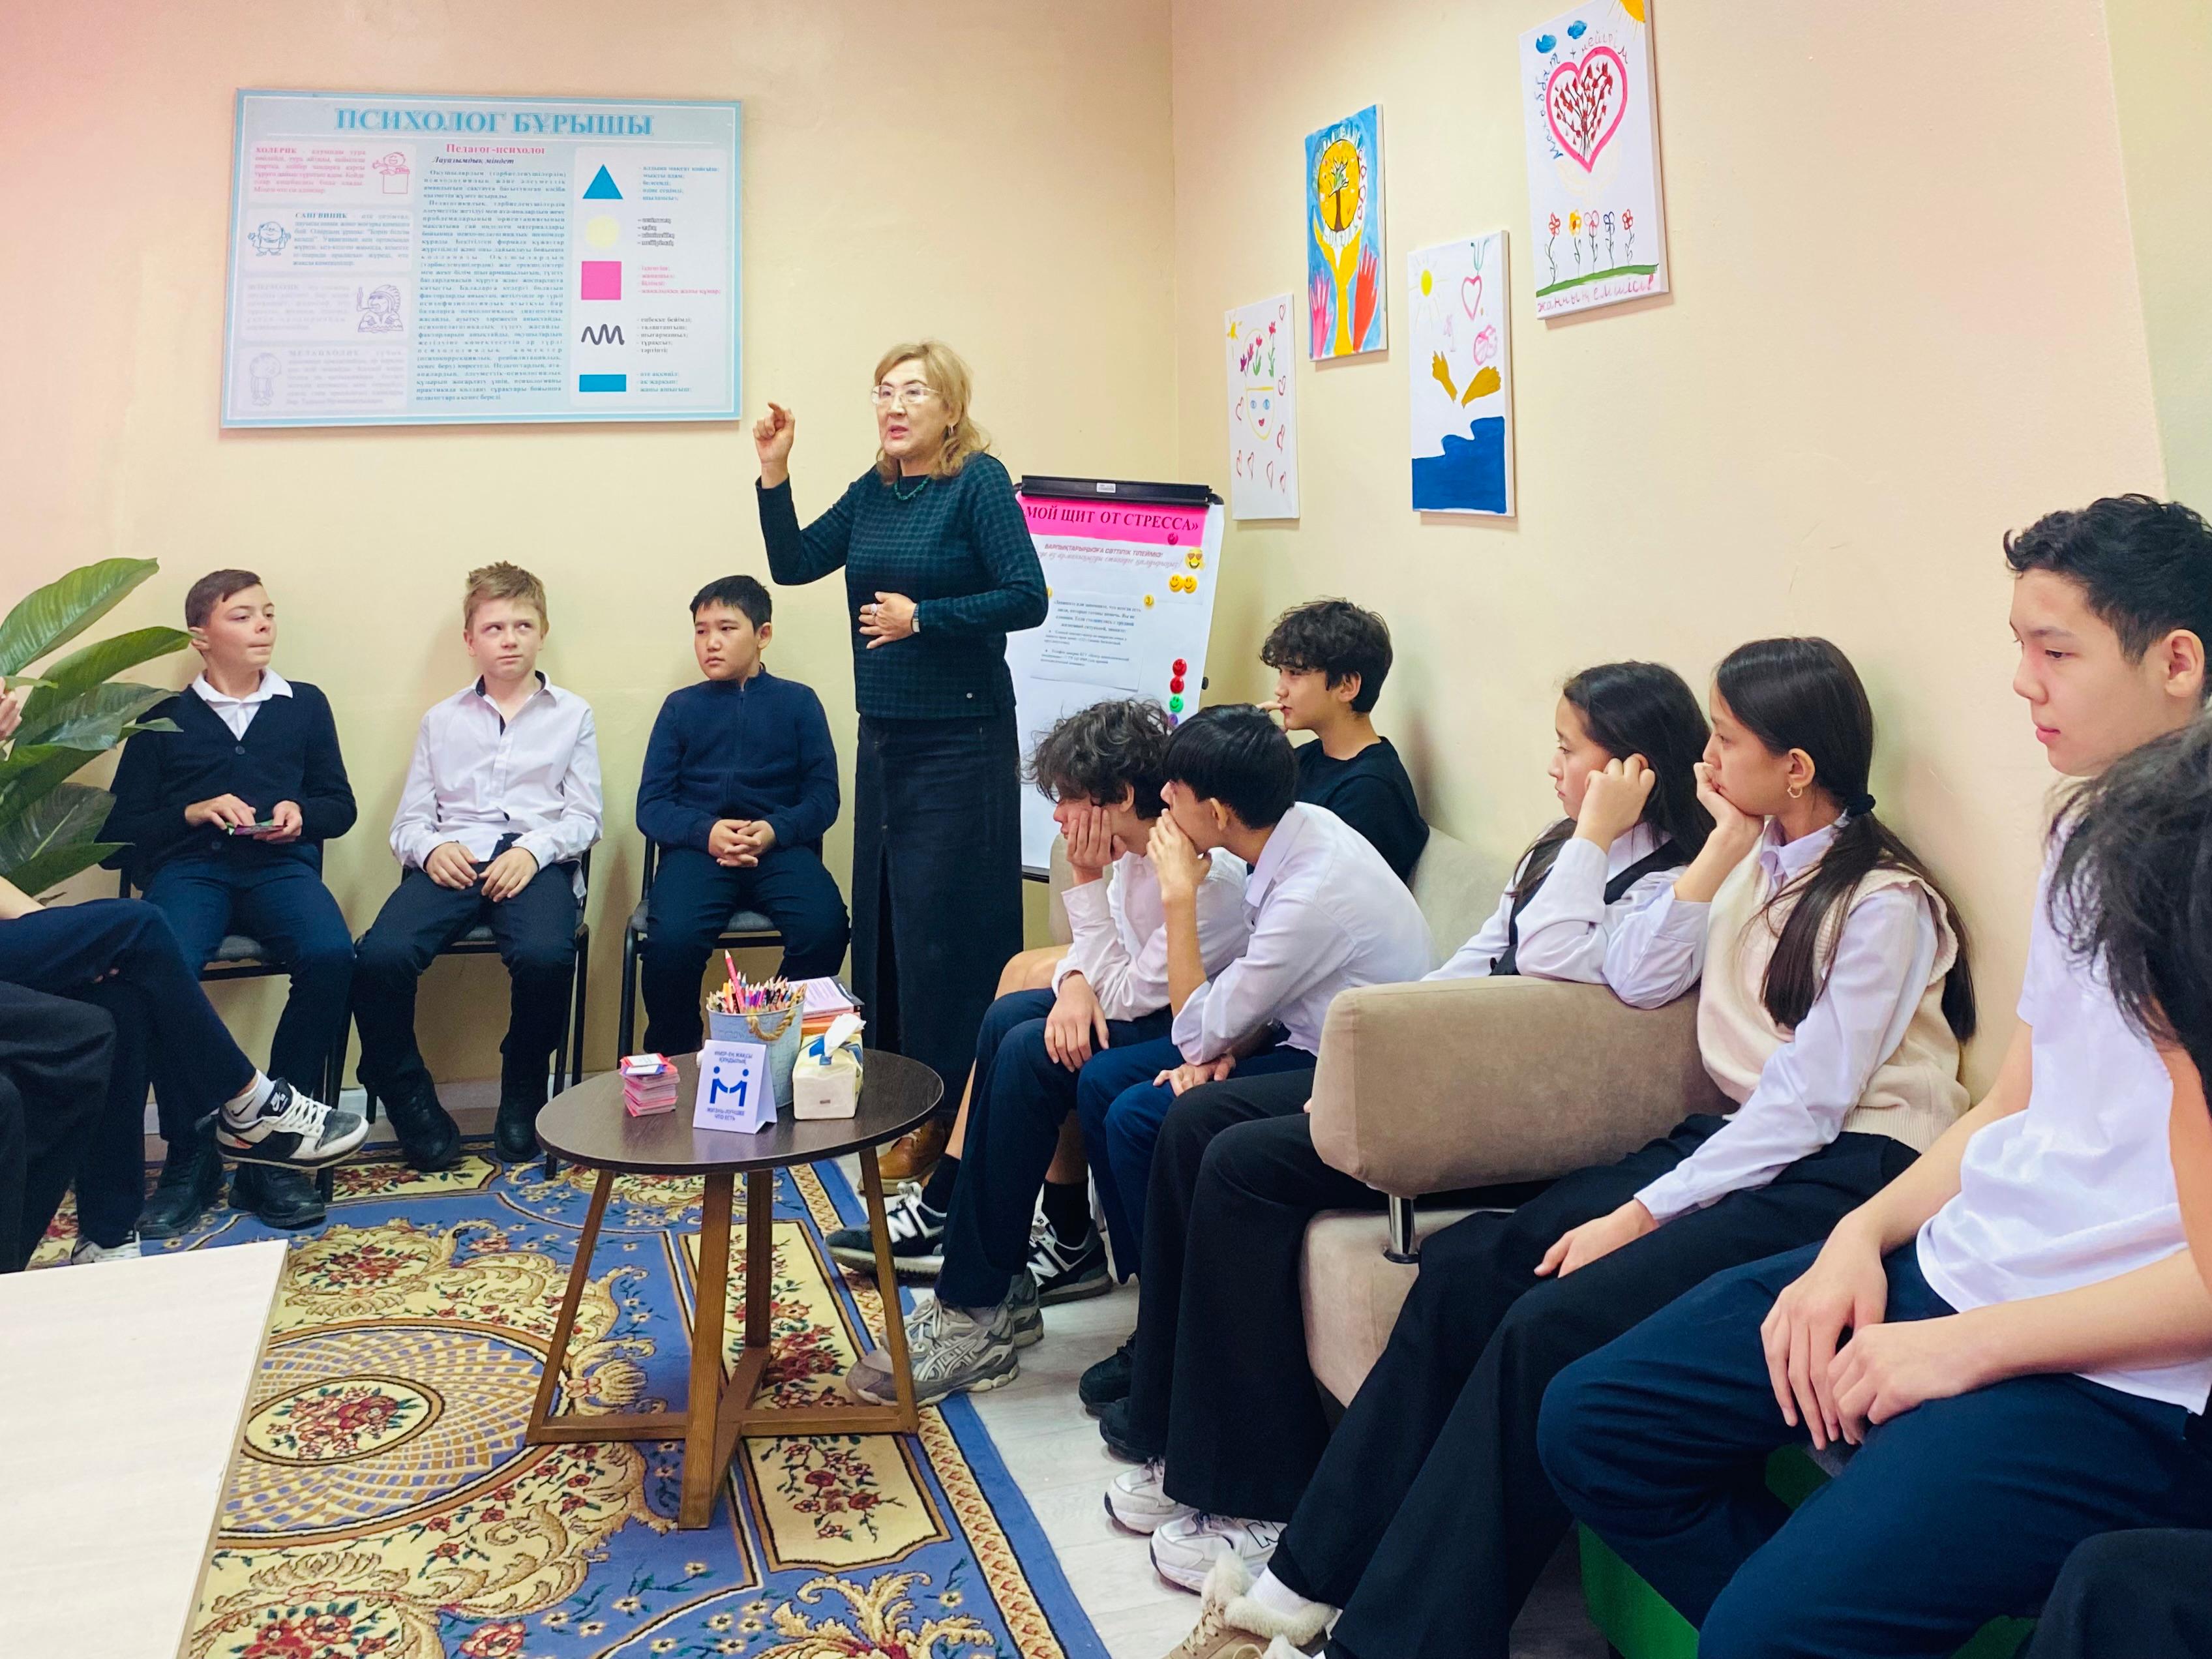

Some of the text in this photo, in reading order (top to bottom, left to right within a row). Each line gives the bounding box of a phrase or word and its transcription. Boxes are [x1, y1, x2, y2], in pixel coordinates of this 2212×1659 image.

[333, 108, 506, 132] ПСИХОЛОГ
[1061, 509, 1096, 524] ЩИТ
[1100, 511, 1121, 524] ОТ
[1123, 514, 1199, 531] СТРЕССА»
[886, 1209, 918, 1243] N
